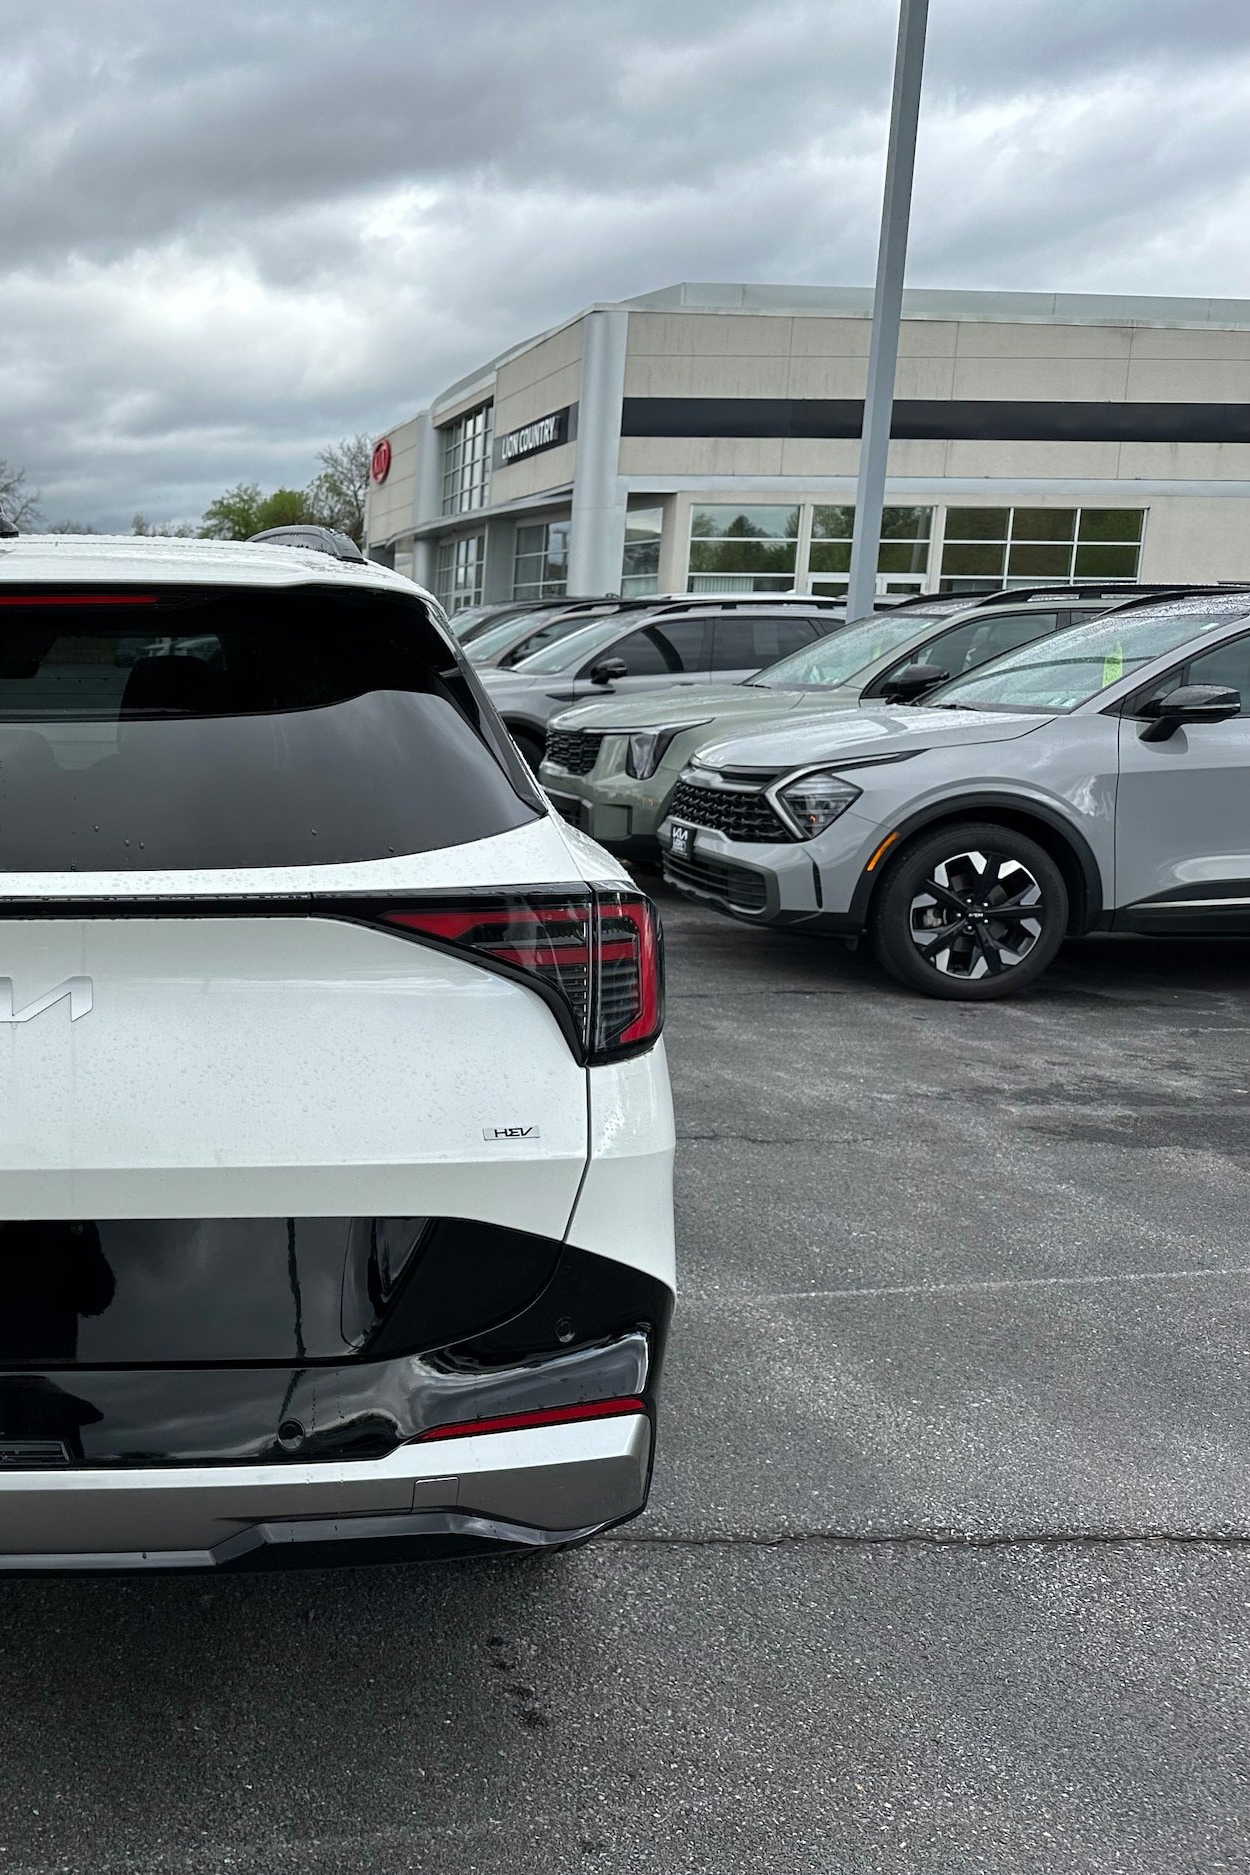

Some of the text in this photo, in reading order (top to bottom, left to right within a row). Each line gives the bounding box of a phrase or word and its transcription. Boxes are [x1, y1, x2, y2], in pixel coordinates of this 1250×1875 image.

[501, 416, 556, 460] LION COUNTRY
[672, 826, 688, 841] KIA
[494, 1126, 534, 1138] HEV
